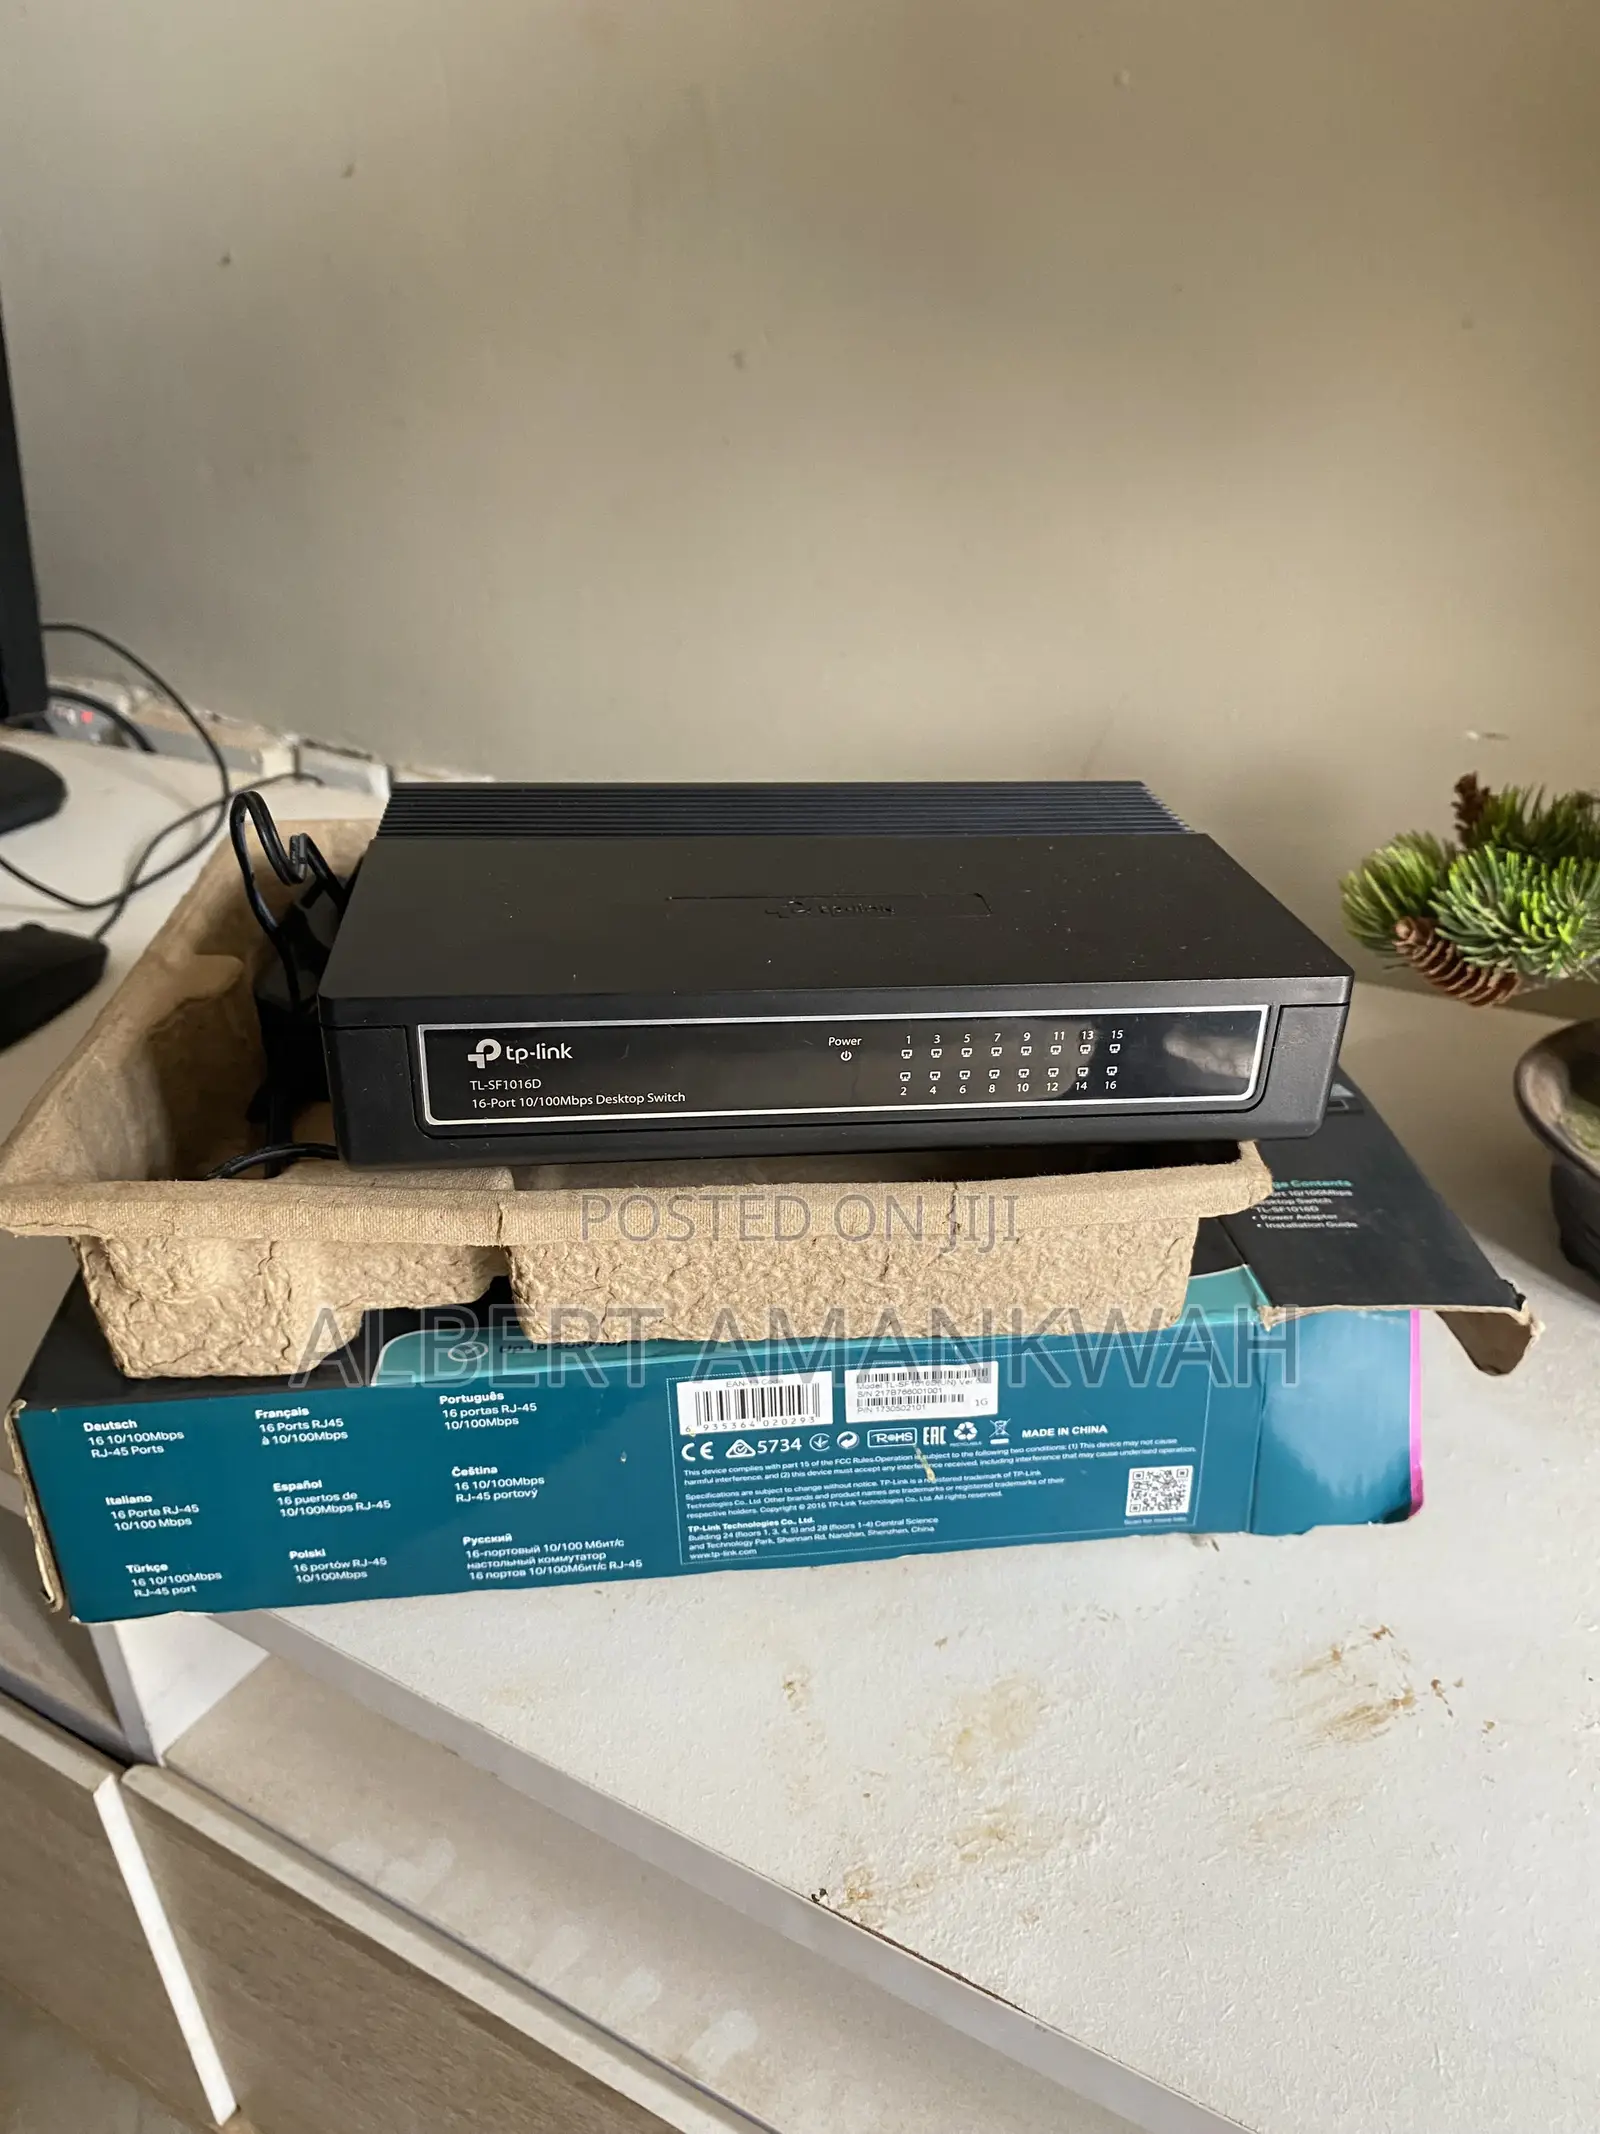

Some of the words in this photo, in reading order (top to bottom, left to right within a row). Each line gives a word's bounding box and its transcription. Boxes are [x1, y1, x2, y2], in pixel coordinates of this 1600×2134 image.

[828, 1036, 862, 1046] Power
[905, 1035, 911, 1044] 1
[933, 1035, 941, 1044] 3
[964, 1034, 971, 1043] 5
[994, 1033, 1001, 1042] 7
[1023, 1032, 1031, 1041] 9
[1054, 1031, 1065, 1040] 11
[1081, 1030, 1094, 1040] 13
[1111, 1030, 1123, 1039] 15
[506, 1043, 573, 1064] tp-link
[470, 1079, 542, 1091] TL-SF1016D
[900, 1087, 907, 1095] 2
[929, 1086, 937, 1094] 4
[959, 1085, 966, 1094] 6
[988, 1084, 996, 1093] 8
[1017, 1083, 1029, 1092] 10
[1046, 1082, 1058, 1091] 12
[1075, 1082, 1088, 1091] 14
[1105, 1081, 1117, 1090] 16
[472, 1097, 516, 1109] 16-Port
[519, 1094, 593, 1108] 10/100Mbps
[596, 1093, 644, 1106] Desktop
[647, 1092, 686, 1103] Switch
[1265, 1221, 1324, 1229] Installation
[439, 1391, 504, 1404] Português
[974, 1398, 988, 1407] 1G
[255, 1407, 309, 1419] Français
[442, 1409, 457, 1418] 16
[460, 1407, 499, 1418] portas
[501, 1402, 537, 1413] RJ-45
[83, 1419, 137, 1432] Deutsch
[259, 1423, 275, 1432] 16
[276, 1422, 309, 1431] Ports
[311, 1418, 344, 1428] RJ45
[444, 1417, 519, 1430] 10/100Mbps
[703, 1420, 755, 1431] 935364
[763, 1417, 815, 1428] 020293
[88, 1436, 104, 1445] 16
[107, 1431, 184, 1444] 10/100Mbps
[262, 1436, 269, 1445] à
[272, 1431, 348, 1444] 10/100Mbps
[1022, 1428, 1055, 1438] MADE
[1058, 1427, 1068, 1436] IN
[1072, 1425, 1108, 1435] CHINA
[91, 1447, 128, 1458] RJ-45
[130, 1445, 164, 1454] Ports
[757, 1438, 801, 1454] 5734
[451, 1466, 497, 1477] Čeština
[273, 1479, 322, 1492] Español
[454, 1482, 469, 1490] 16
[472, 1477, 544, 1489] 10/100Mbps
[105, 1495, 152, 1505] Italiano
[277, 1496, 292, 1505] 16
[294, 1494, 340, 1505] puertos
[342, 1491, 357, 1500] de
[456, 1491, 490, 1502] RJ-45
[493, 1488, 537, 1501] portový
[110, 1510, 126, 1519] 16
[128, 1508, 160, 1518] Porte
[162, 1504, 199, 1515] RJ-45
[280, 1504, 353, 1517] 10/100Mbps
[355, 1500, 391, 1510] RJ-45
[114, 1520, 156, 1531] 10/100
[158, 1518, 192, 1527] Mbps
[688, 1524, 721, 1532] TP-Link
[722, 1520, 779, 1530] Technologies
[462, 1533, 512, 1546] Русский
[289, 1548, 326, 1559] Polski
[466, 1545, 540, 1558] 16-портовый
[543, 1541, 582, 1552] 10/100
[584, 1538, 624, 1549] Мбит/с
[689, 1549, 757, 1559] www.tp-link.com
[293, 1563, 308, 1572] 16
[310, 1560, 350, 1572] portów
[352, 1557, 387, 1567] RJ-45
[467, 1556, 535, 1569] настольный
[538, 1552, 606, 1563] коммутатор
[125, 1564, 168, 1573] Türkçe
[469, 1571, 483, 1579] 16
[485, 1570, 526, 1579] портов
[529, 1562, 606, 1575] 10/100Мбит/с
[609, 1559, 642, 1569] RJ-45
[131, 1578, 146, 1586] 16
[149, 1572, 222, 1585] 10/100Mbps
[296, 1571, 367, 1582] 10/100Mbps
[133, 1587, 169, 1597] RJ-45
[171, 1585, 196, 1595] port
